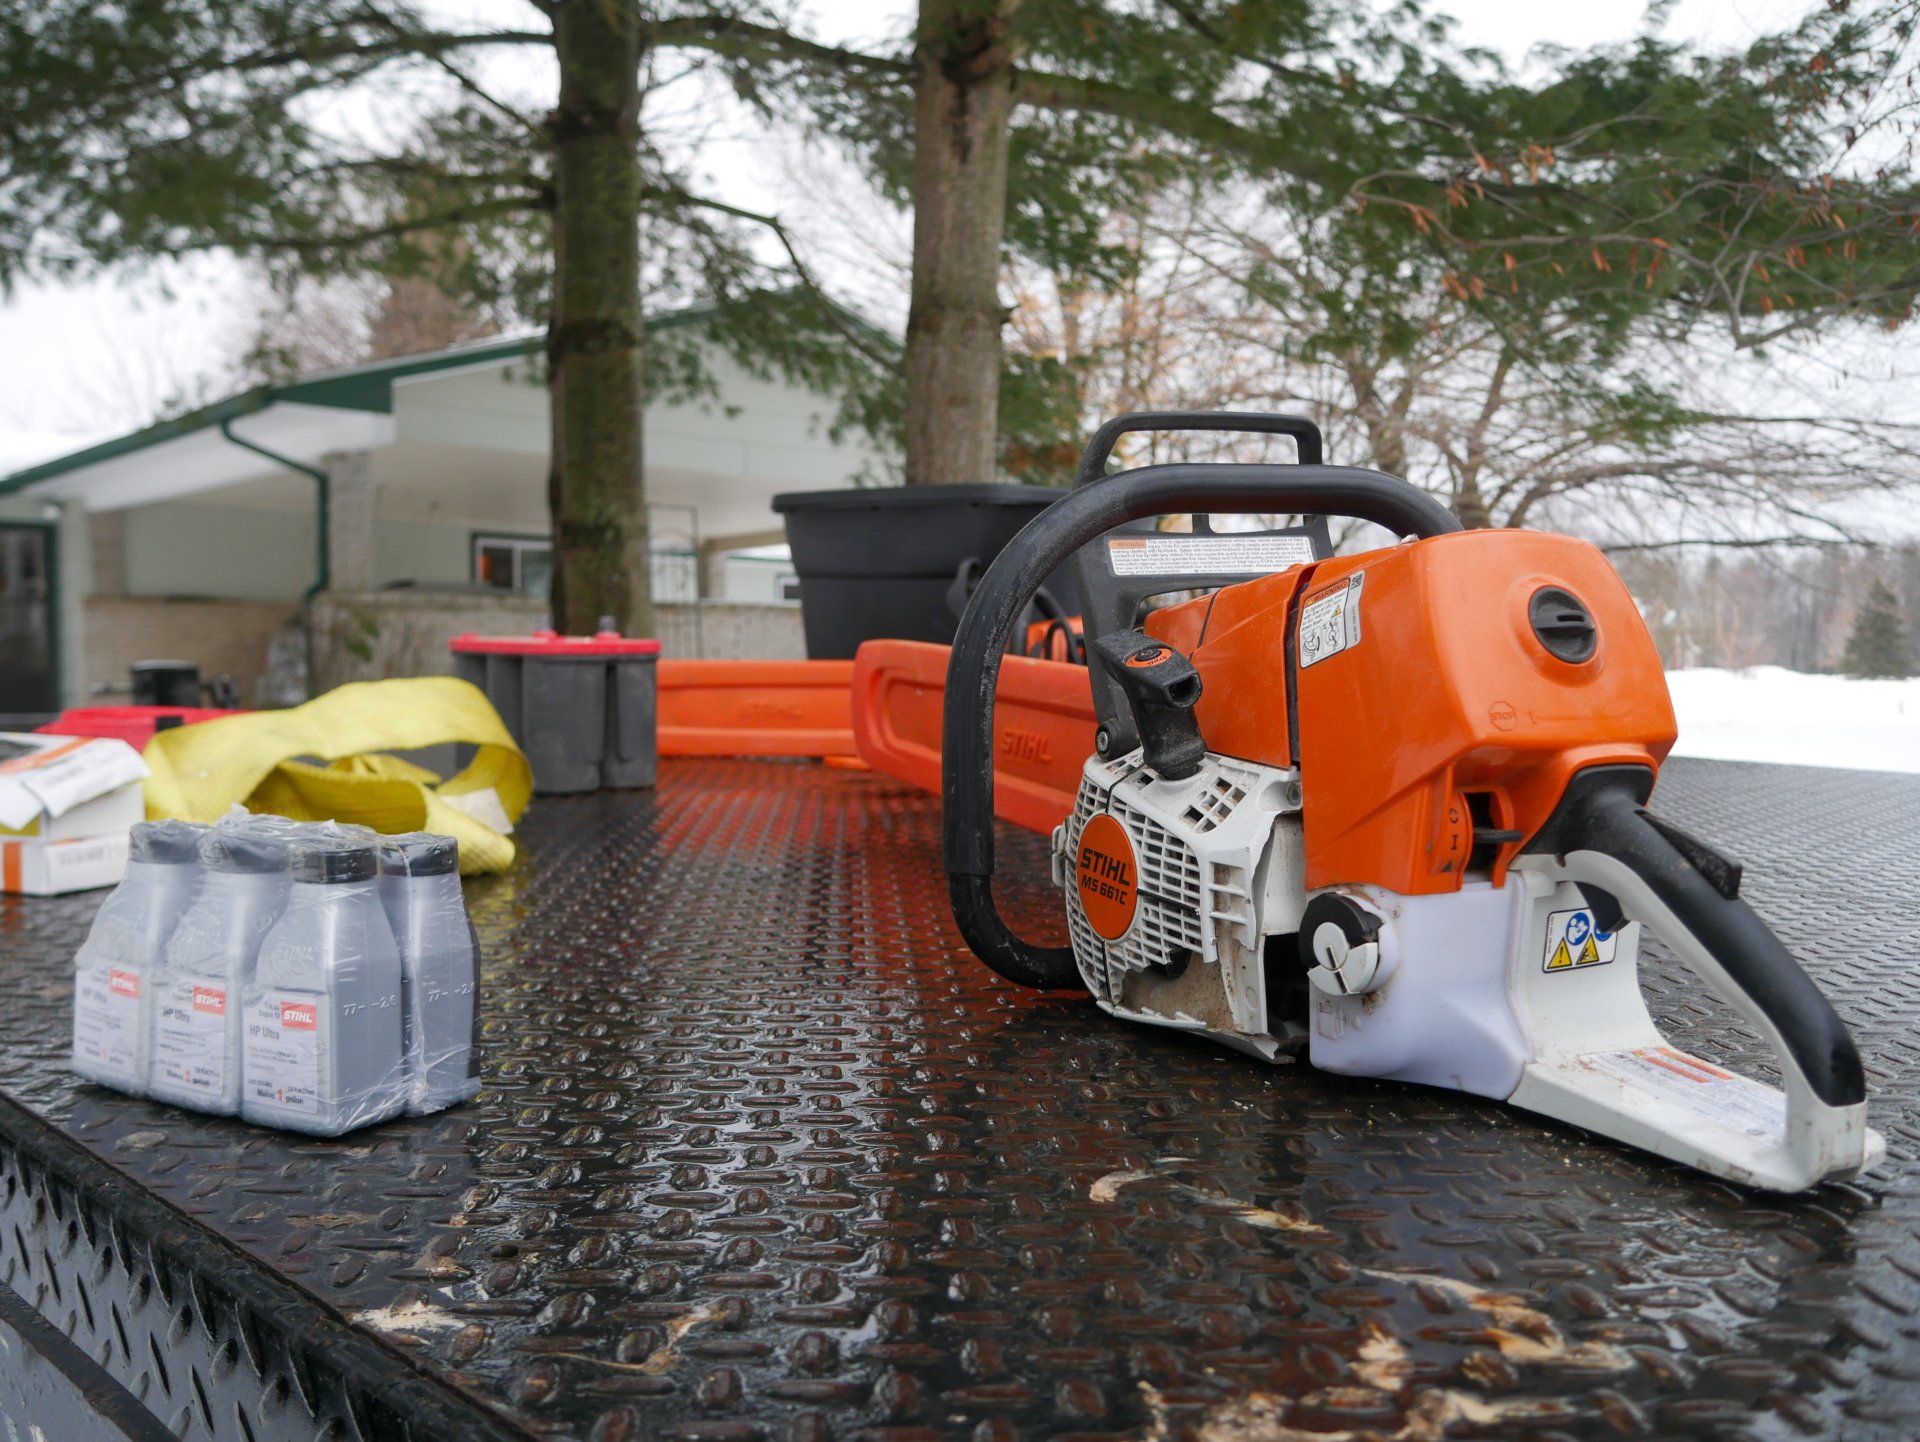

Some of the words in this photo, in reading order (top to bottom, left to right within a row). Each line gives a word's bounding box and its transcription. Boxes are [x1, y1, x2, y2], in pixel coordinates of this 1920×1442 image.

[1002, 731, 1052, 765] STIHL
[1081, 848, 1131, 887] STIHL
[1081, 874, 1098, 892] MS
[1100, 882, 1128, 906] 661C
[111, 977, 136, 993] STIHL
[195, 994, 223, 1008] STIHL
[283, 1010, 313, 1023] STIHL
[250, 1025, 260, 1036] HP
[262, 1026, 280, 1040] Ultra
[257, 1089, 275, 1099] Makes
[285, 1096, 304, 1105] gallon
